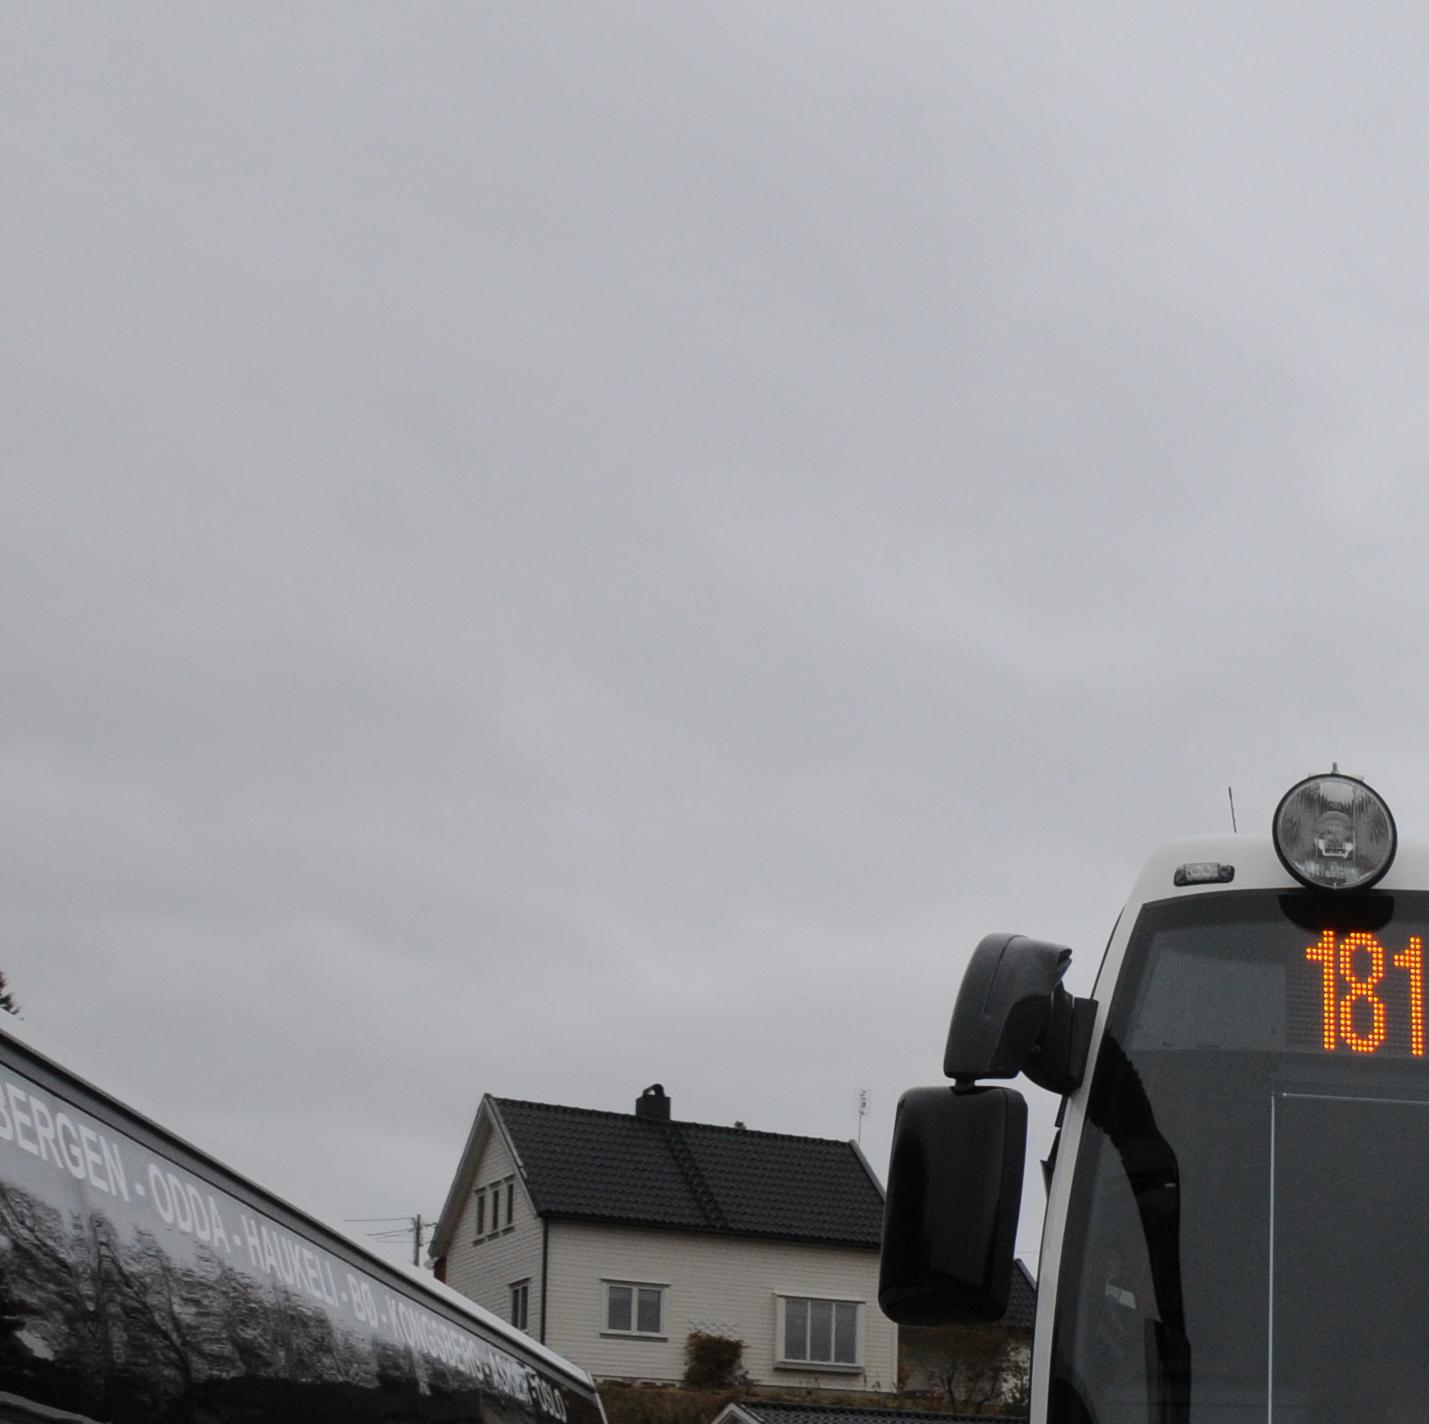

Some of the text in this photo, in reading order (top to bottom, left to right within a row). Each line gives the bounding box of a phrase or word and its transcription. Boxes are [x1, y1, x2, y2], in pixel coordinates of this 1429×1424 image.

[1305, 930, 1426, 1057] 181
[148, 1163, 231, 1253] ODDA
[241, 1214, 339, 1308] HAUKELI
